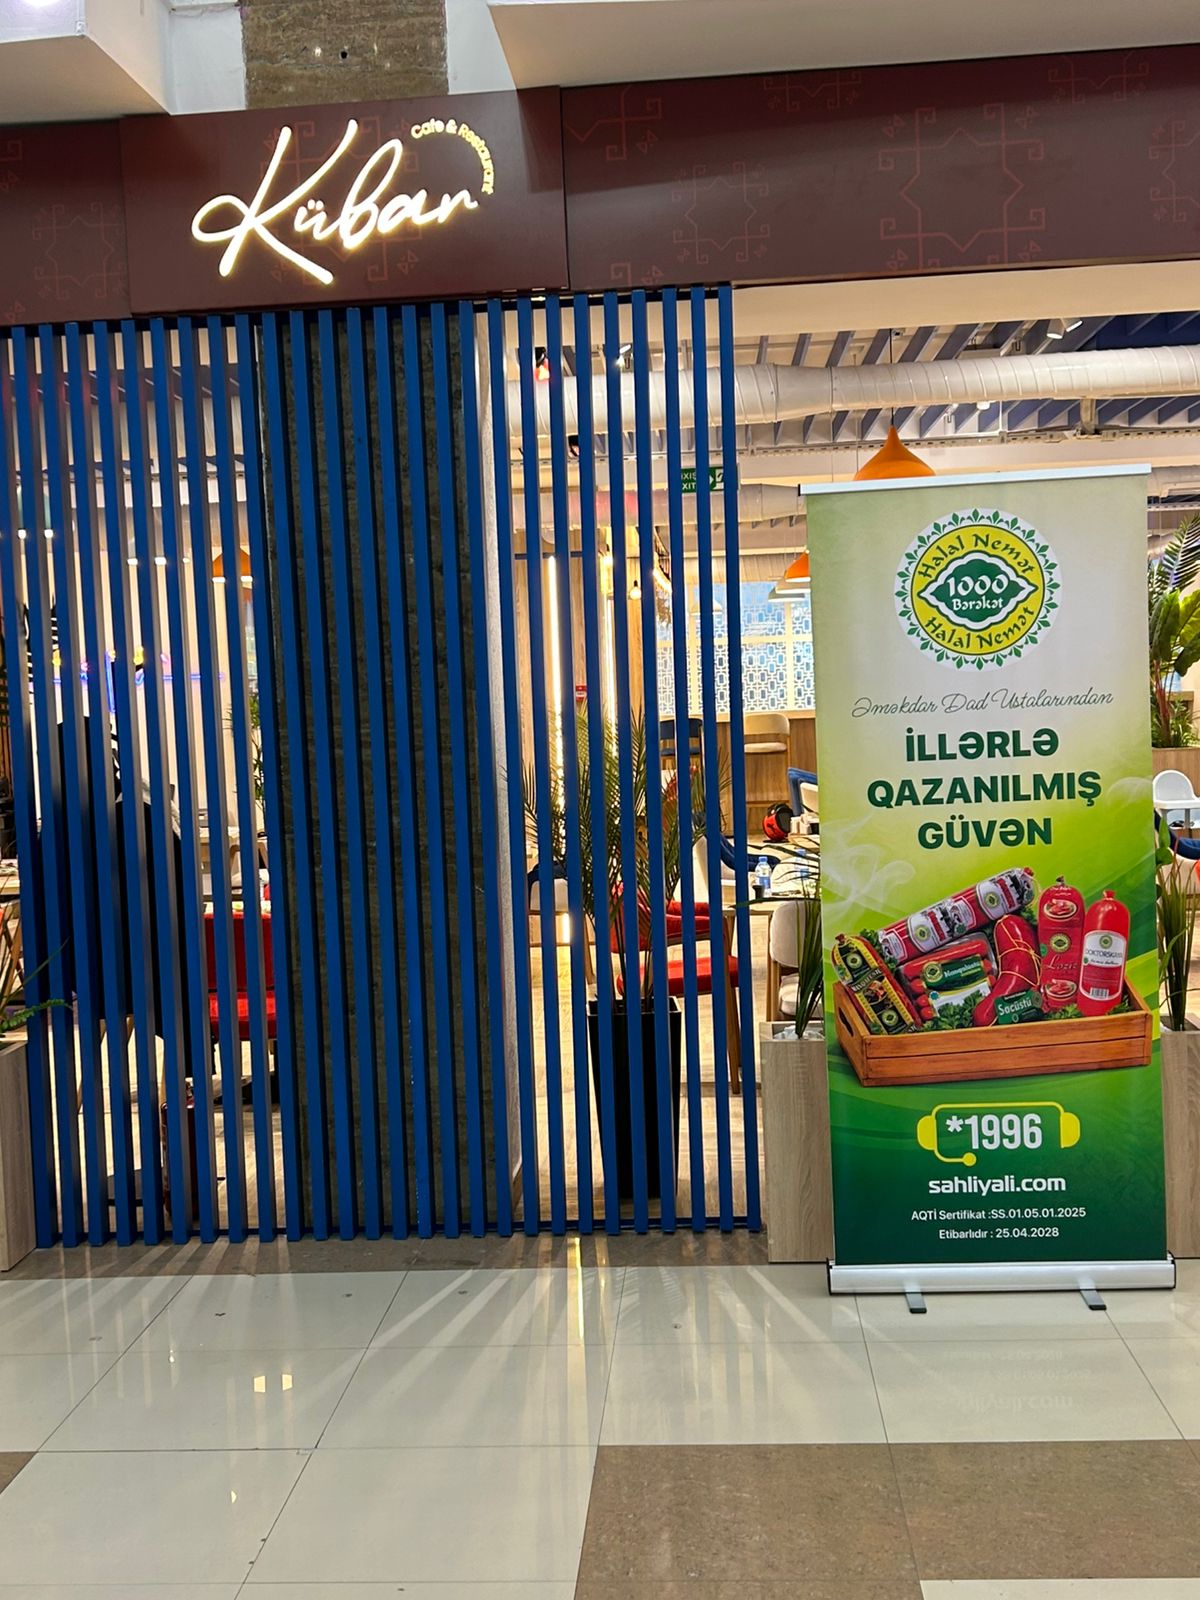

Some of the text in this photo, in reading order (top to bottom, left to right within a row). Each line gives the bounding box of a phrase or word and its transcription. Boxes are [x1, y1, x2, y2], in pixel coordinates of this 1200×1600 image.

[411, 118, 445, 139] Cafe
[458, 123, 494, 195] Restaurant
[918, 535, 965, 579] Halal
[947, 574, 1009, 597] 1000
[924, 616, 970, 649] Halal
[851, 697, 938, 718] Əməkdar
[941, 692, 989, 714] Dad
[905, 727, 1059, 762] İLLƏRLƏ
[867, 771, 1101, 809] QAZANILMIŞ
[917, 814, 1052, 849] GÜVƏN
[928, 1175, 1066, 1196] sahliyali.com
[939, 1210, 986, 1220] Sertifikat
[995, 1227, 1059, 1238] 25.04.2028
